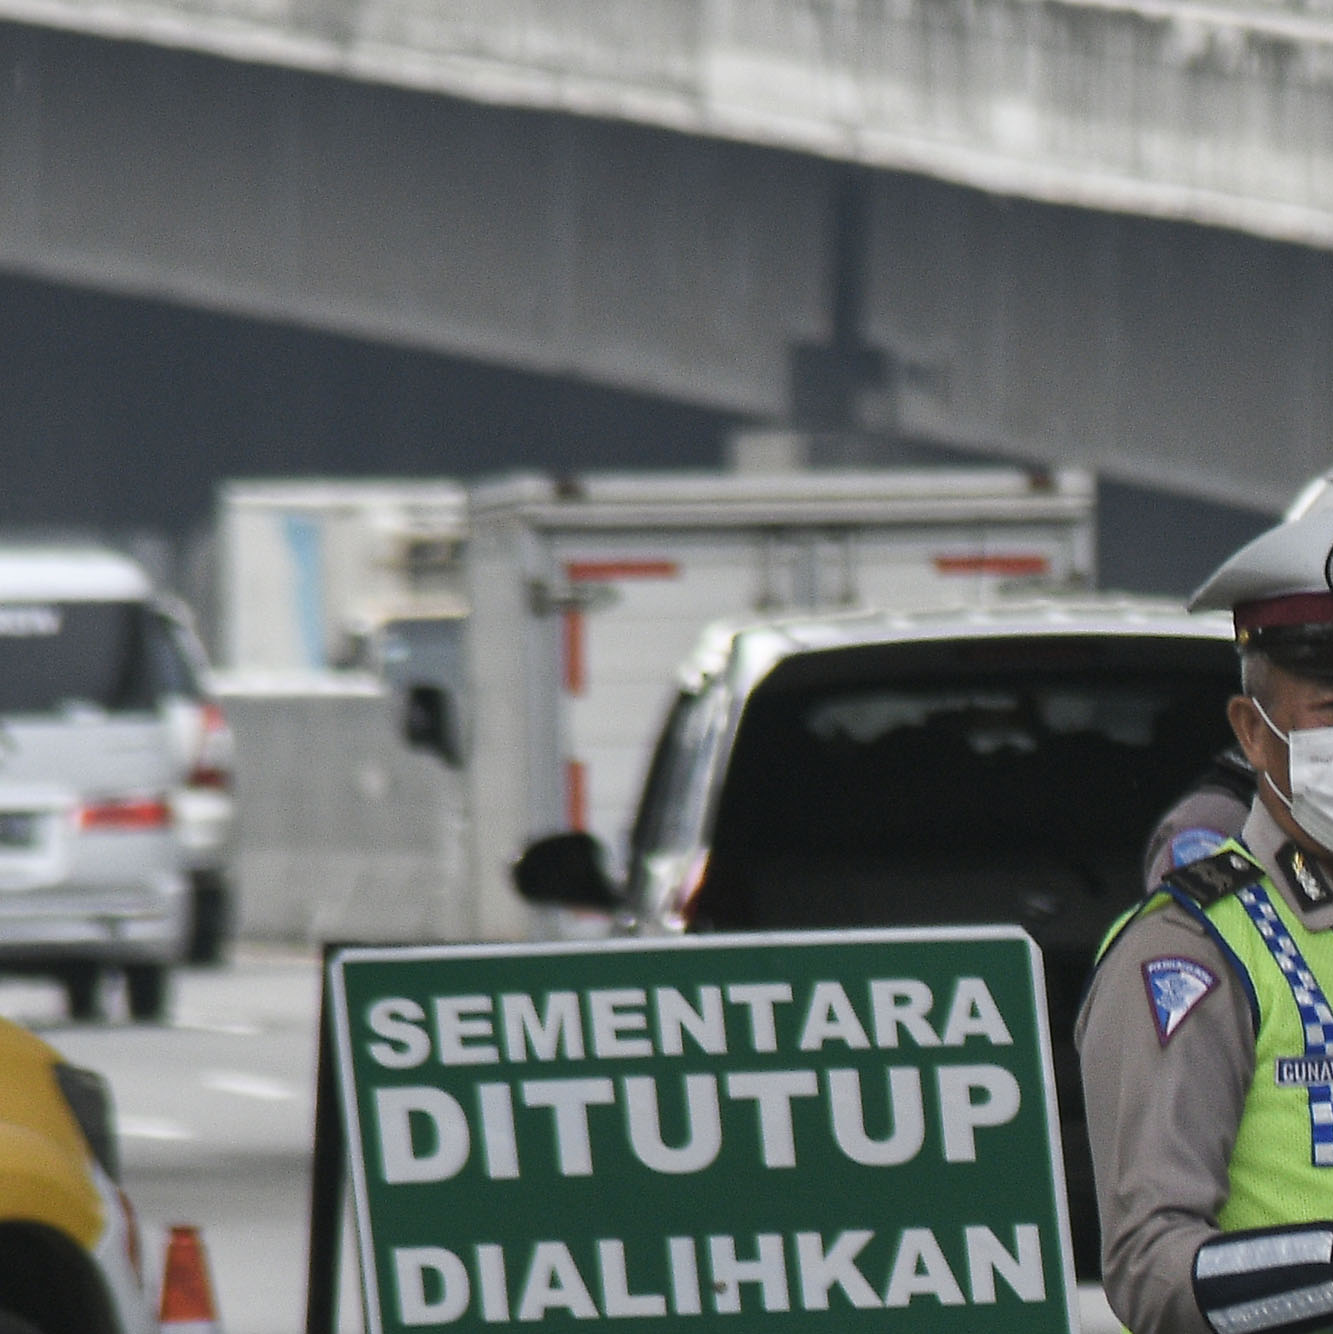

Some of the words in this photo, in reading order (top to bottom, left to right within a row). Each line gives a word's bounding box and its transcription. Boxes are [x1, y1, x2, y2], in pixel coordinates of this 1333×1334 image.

[366, 976, 1013, 1069] SEMENTARA
[373, 1063, 1022, 1185] DITUTUP
[391, 1223, 1046, 1326] DIALIHKAN
